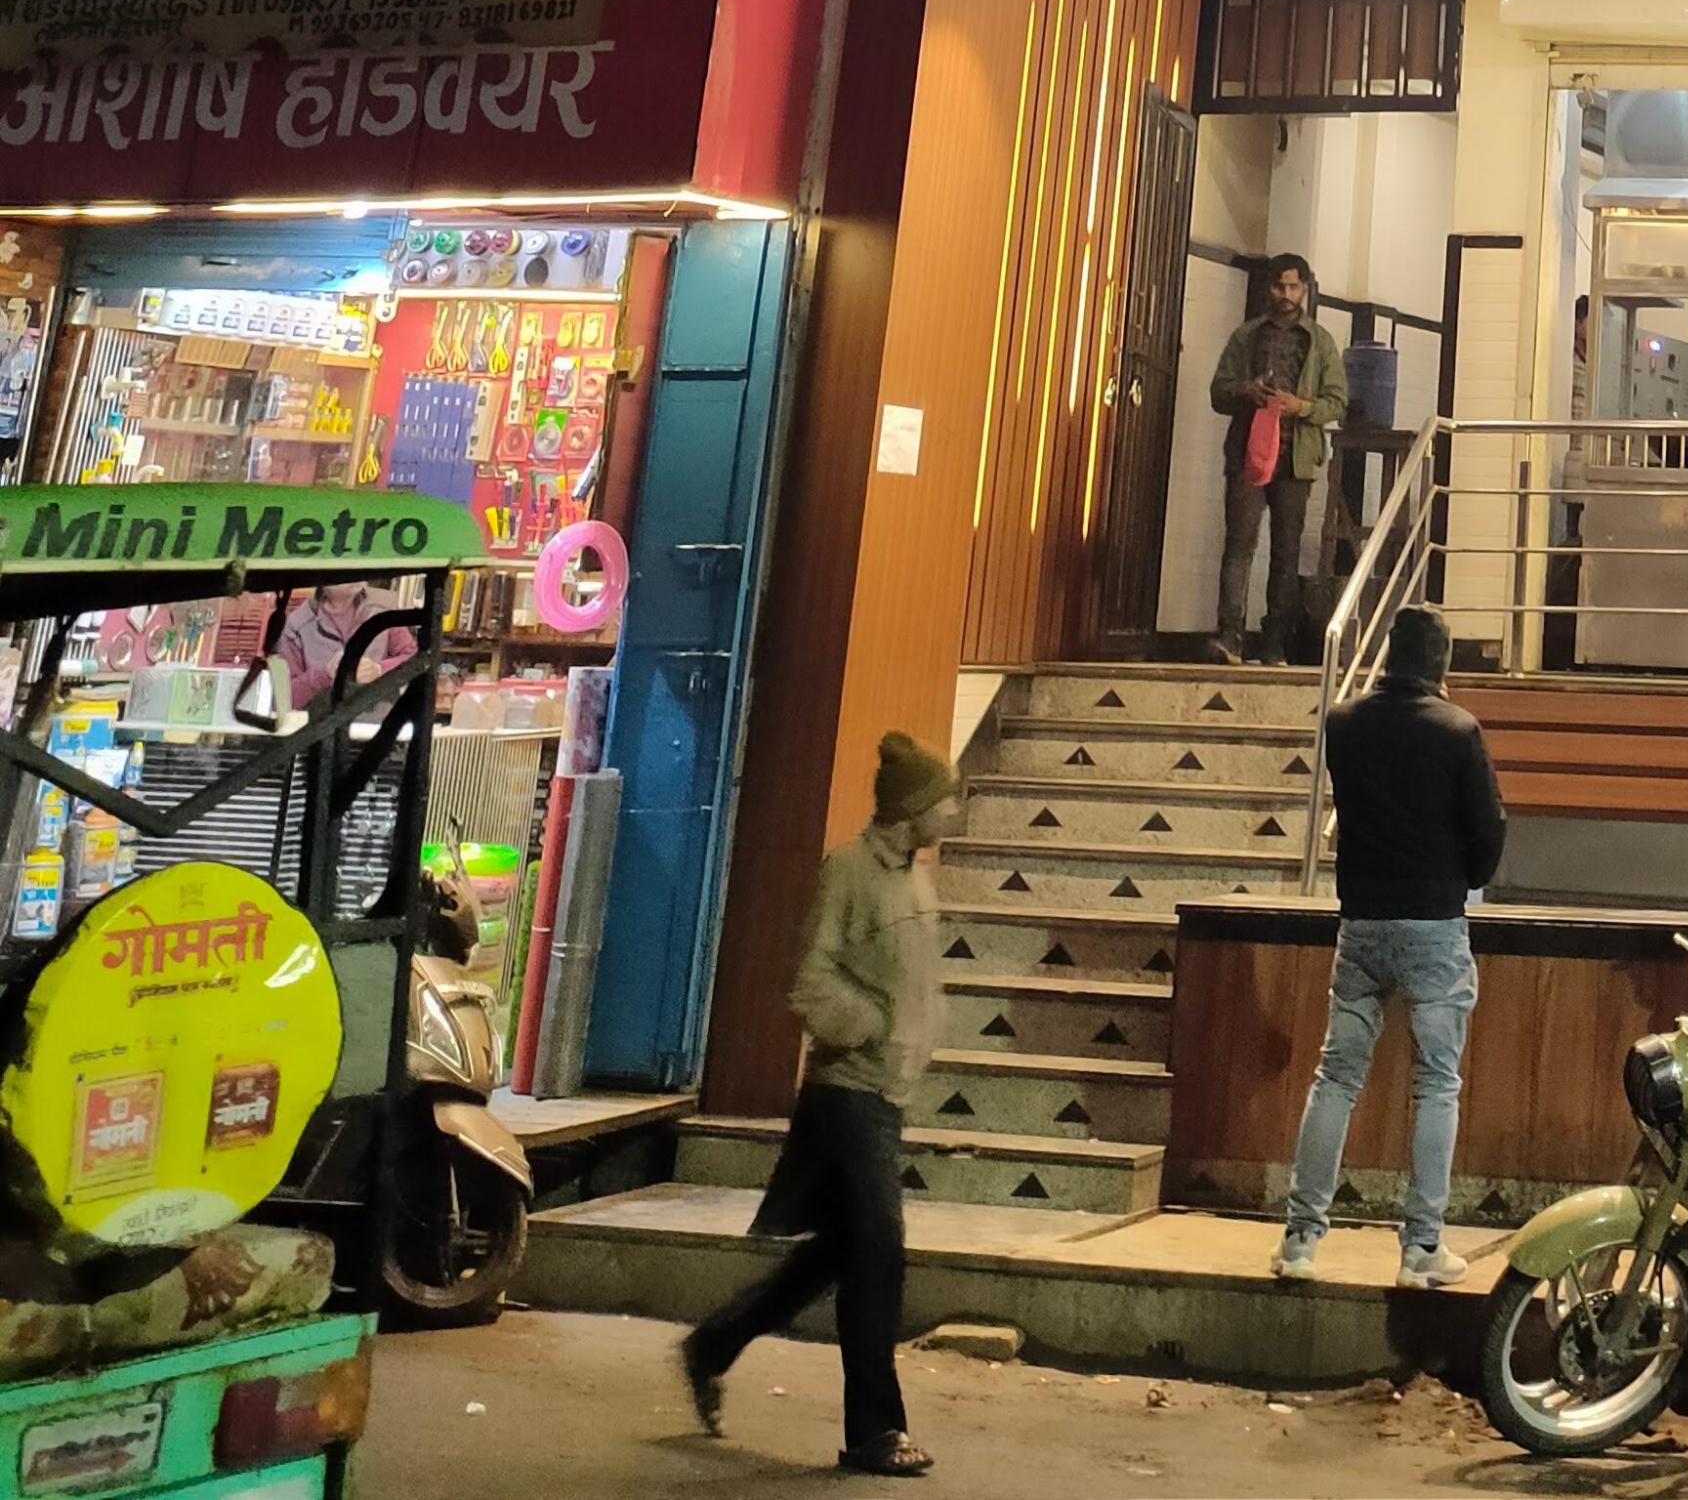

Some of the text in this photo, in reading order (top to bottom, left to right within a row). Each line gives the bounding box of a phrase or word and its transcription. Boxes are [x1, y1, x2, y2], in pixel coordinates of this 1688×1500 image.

[20, 501, 197, 559] Mini
[215, 505, 430, 559] Metro
[102, 900, 273, 976] गोमती
